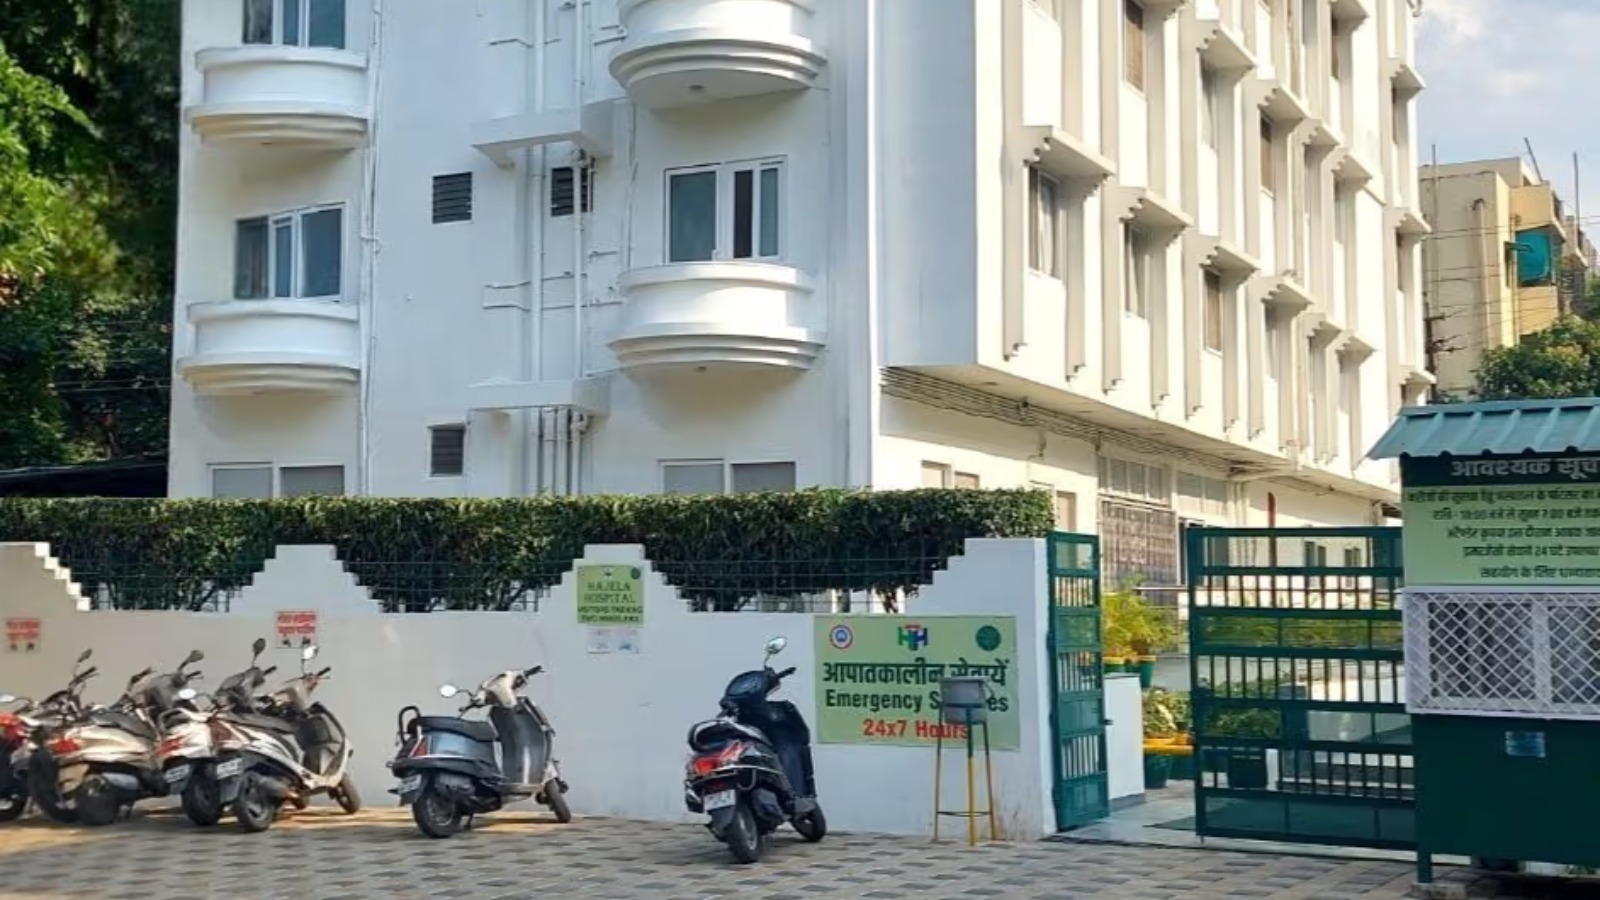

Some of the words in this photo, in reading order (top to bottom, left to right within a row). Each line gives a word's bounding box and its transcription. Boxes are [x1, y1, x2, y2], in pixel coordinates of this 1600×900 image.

[1451, 458, 1551, 477] आवश्यक
[1555, 457, 1600, 480] सूच
[822, 657, 945, 685] आपातकालीन
[826, 689, 923, 713] Emergency
[863, 719, 908, 737] 24x7
[916, 720, 969, 740] Hours
